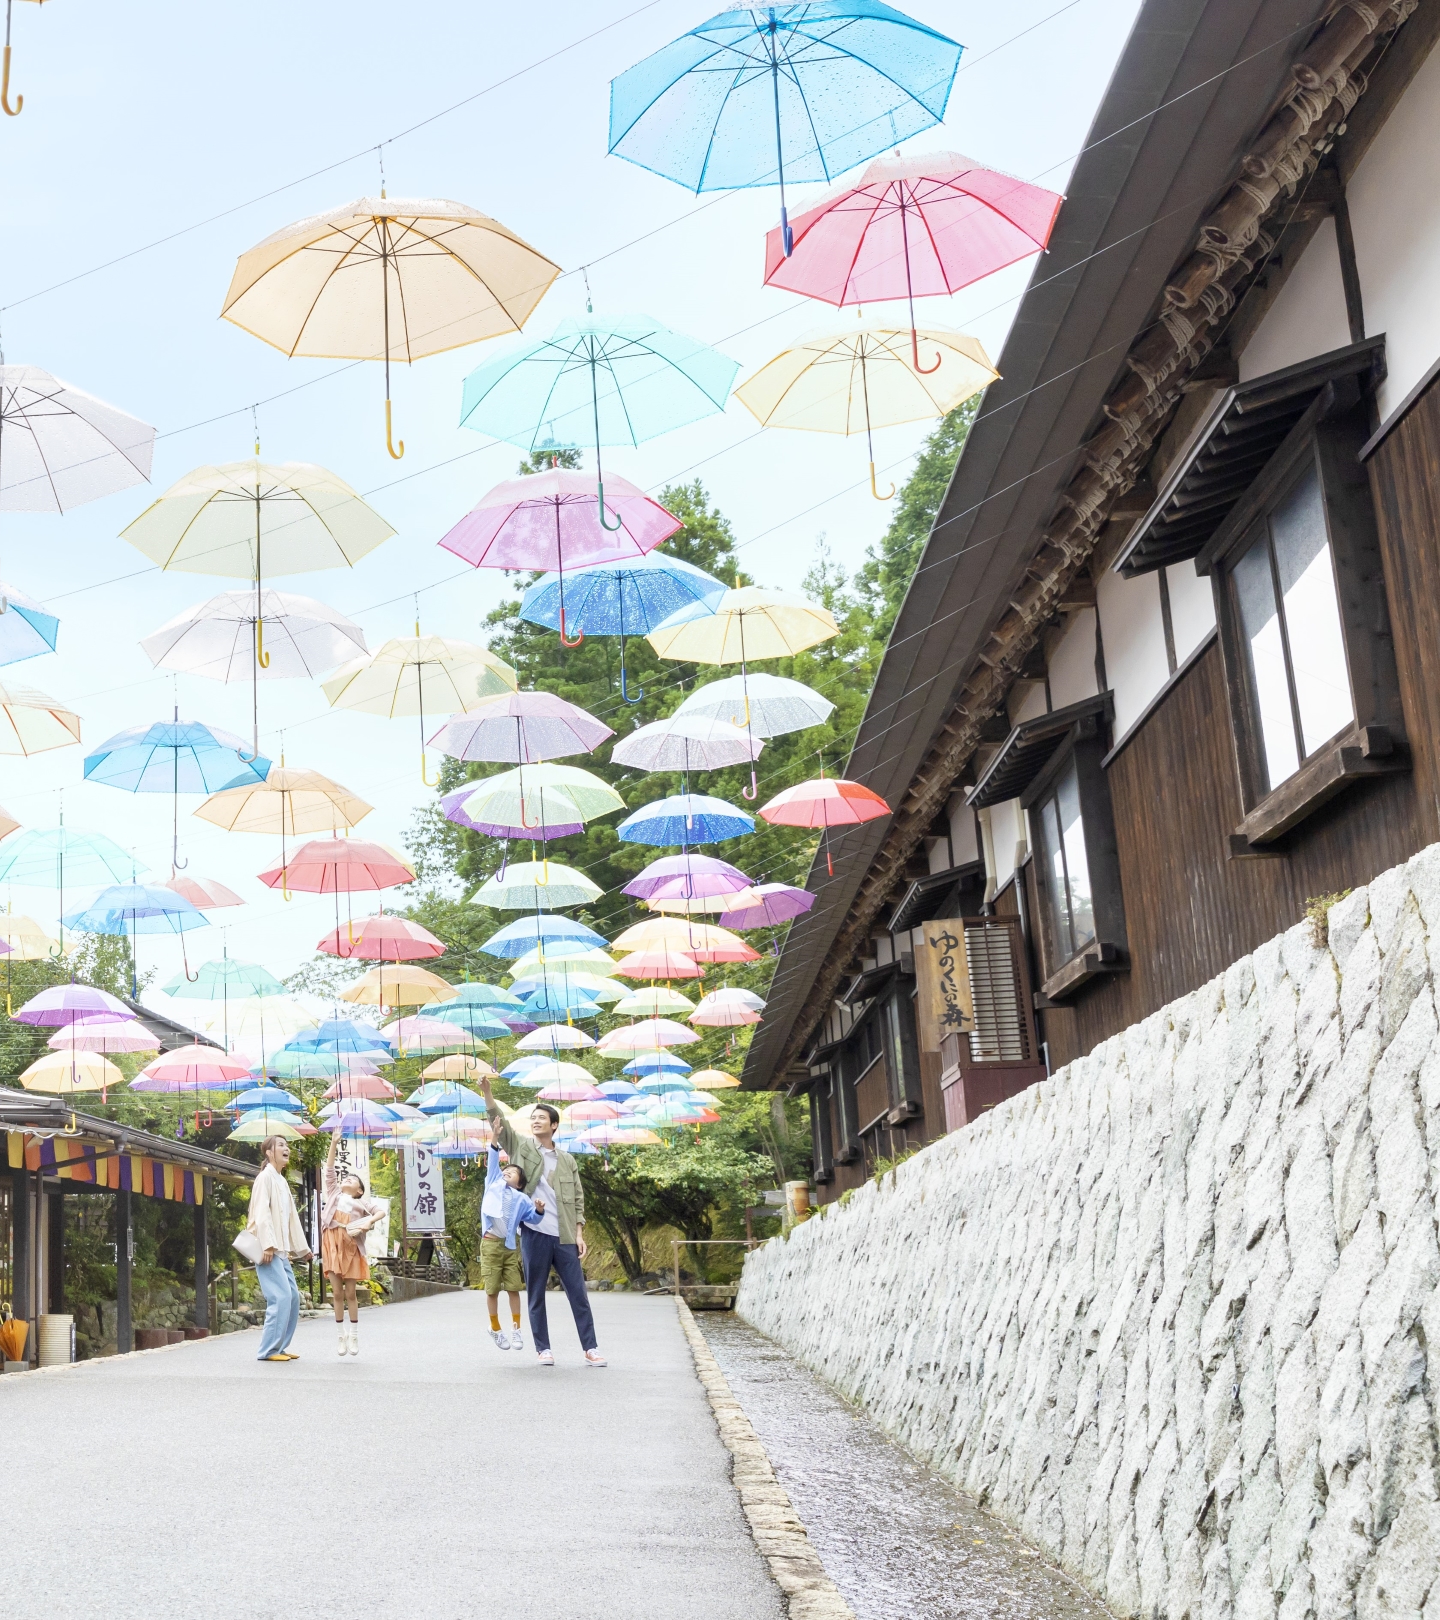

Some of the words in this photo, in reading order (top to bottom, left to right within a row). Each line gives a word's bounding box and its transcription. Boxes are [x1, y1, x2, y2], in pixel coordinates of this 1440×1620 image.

[929, 930, 971, 1027] ゆのくにの森
